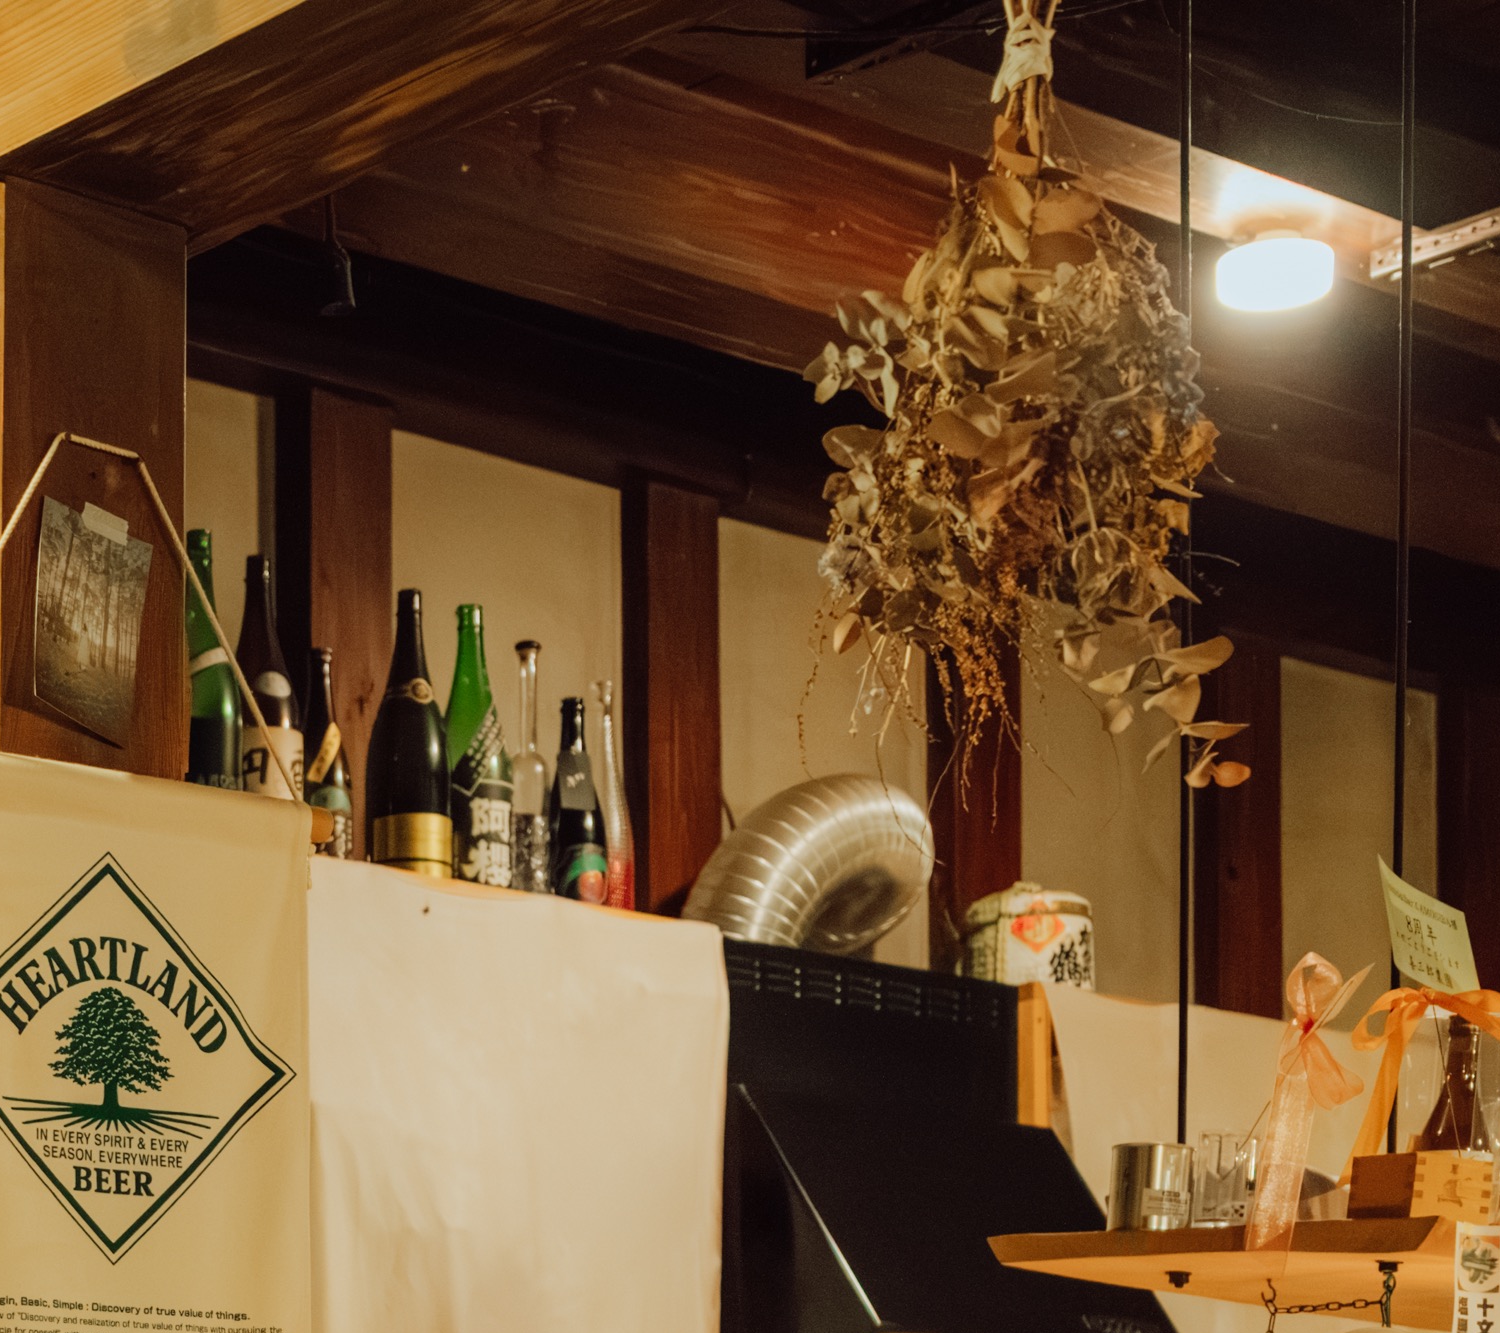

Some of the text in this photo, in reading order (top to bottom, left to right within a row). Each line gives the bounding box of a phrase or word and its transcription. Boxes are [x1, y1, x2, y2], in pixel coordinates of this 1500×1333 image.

[36, 1127, 189, 1153] IN EVERY SPIRIT & EVERY
[43, 1145, 183, 1168] SEASON, EVERYWHERE
[72, 1165, 155, 1197] BEER
[6, 1312, 15, 1320] of
[63, 1316, 77, 1324] and
[122, 1320, 130, 1328] of
[132, 1320, 150, 1328] true
[152, 1322, 173, 1330] value
[175, 1323, 184, 1331] of
[20, 1296, 50, 1308] Basic,
[52, 1299, 84, 1310] Simple
[92, 1302, 140, 1315] Discovery
[144, 1306, 154, 1314] of
[156, 1308, 176, 1316] true
[178, 1308, 203, 1318] value
[205, 1310, 214, 1318] of
[216, 1310, 250, 1322] things.
